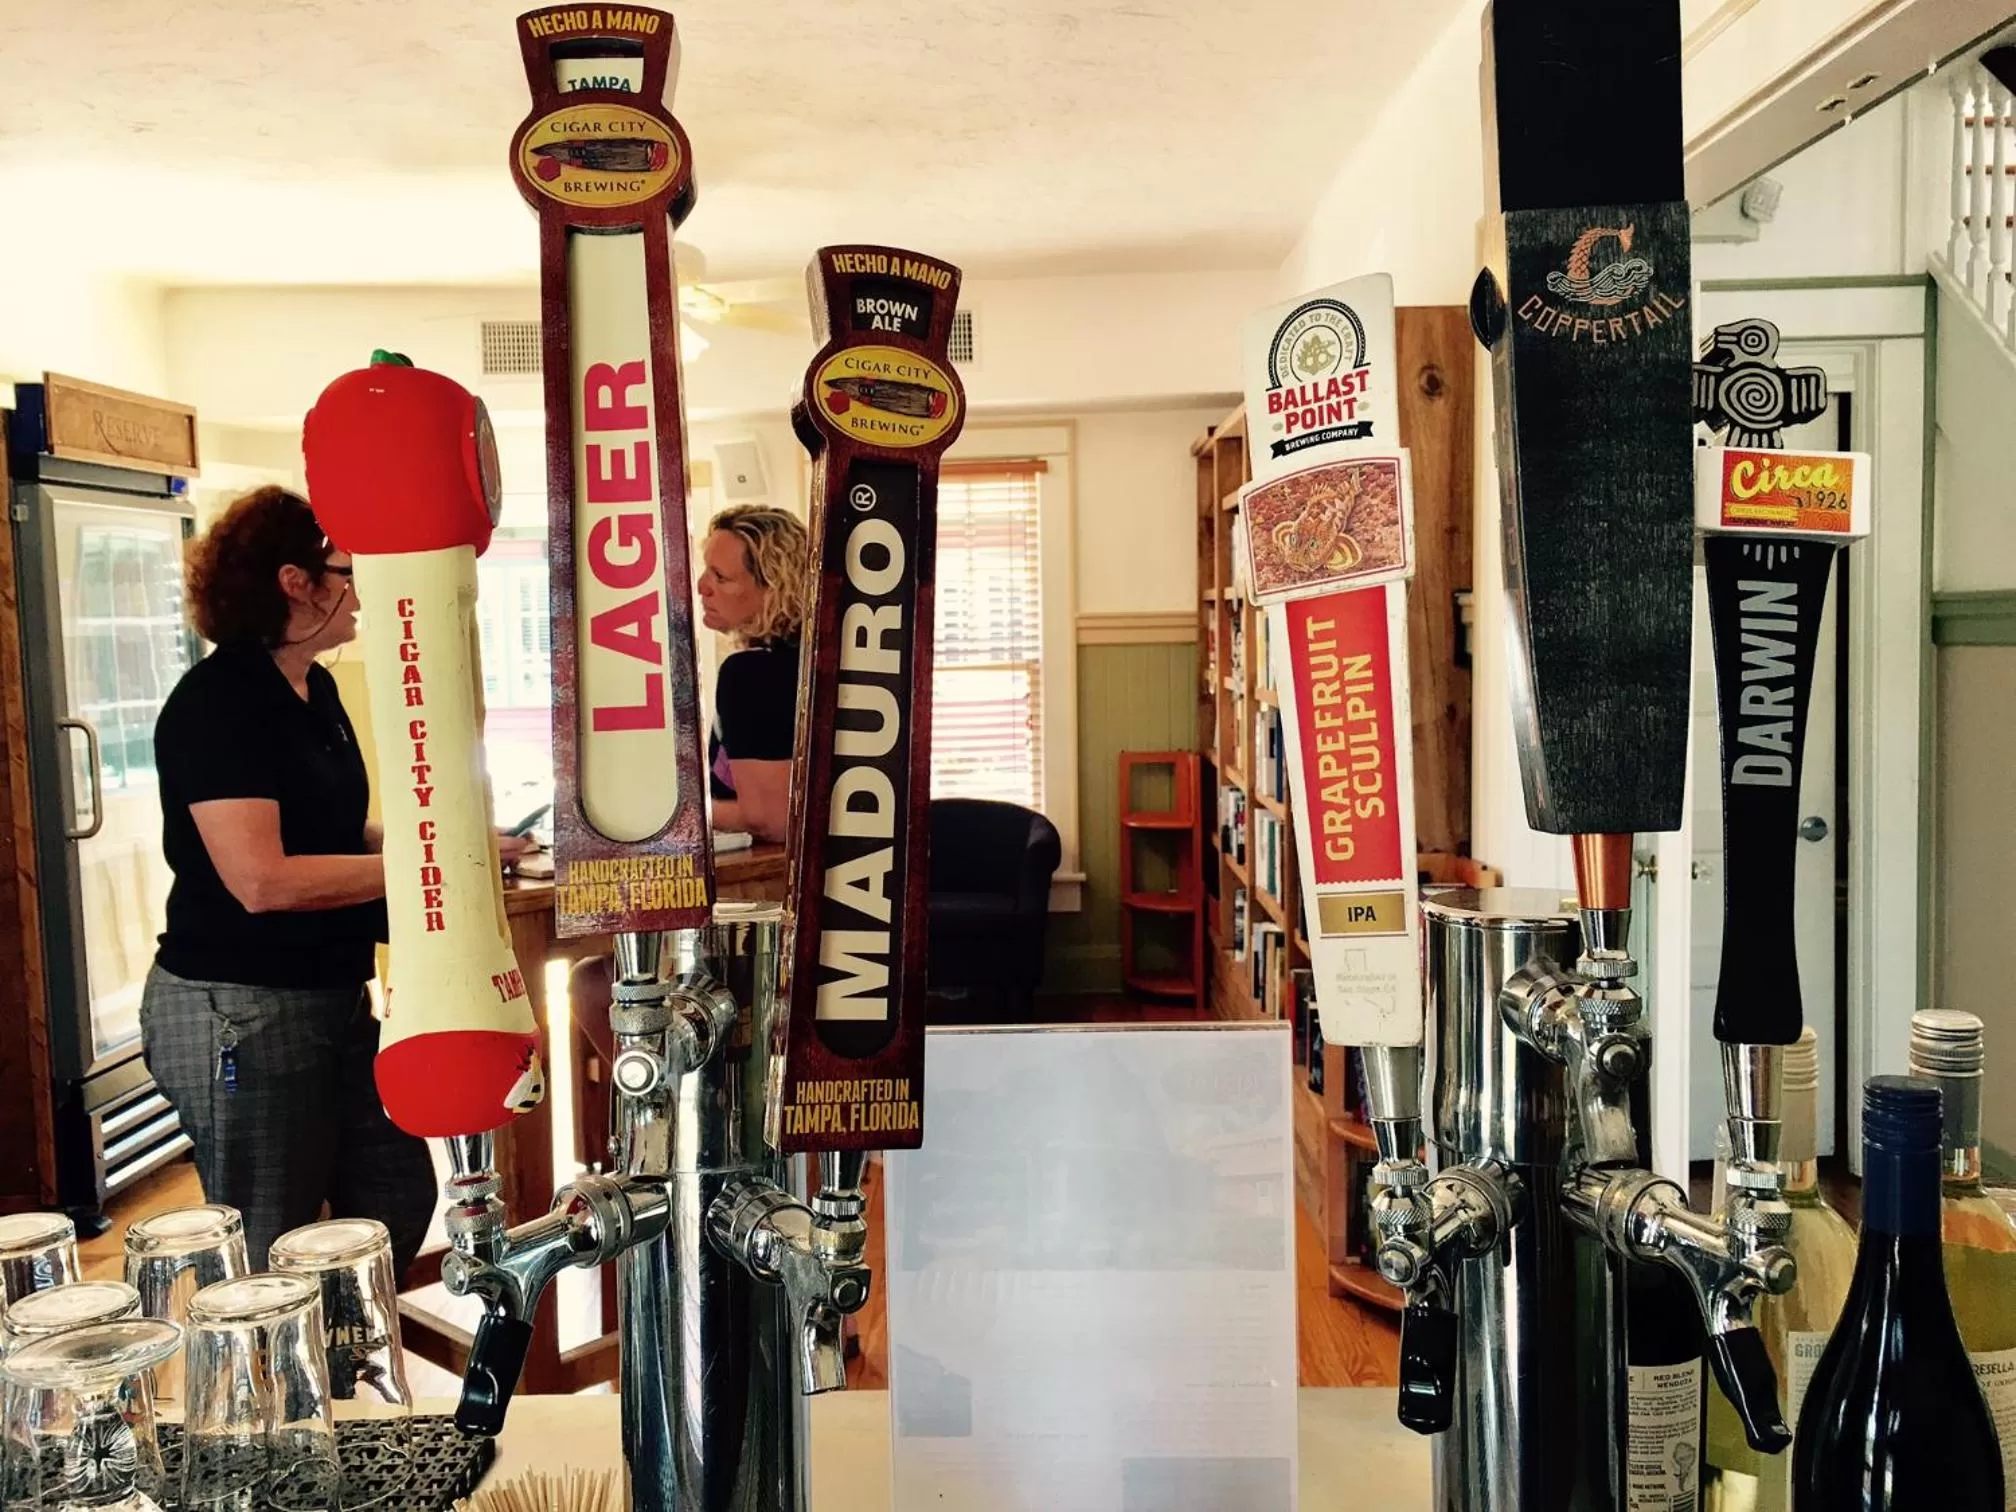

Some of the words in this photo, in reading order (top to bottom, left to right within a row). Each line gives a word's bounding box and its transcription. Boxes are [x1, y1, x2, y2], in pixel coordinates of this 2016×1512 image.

[527, 10, 588, 38] HECHO
[592, 10, 603, 28] A
[607, 10, 661, 34] MANO
[568, 76, 632, 92] TAMPA
[550, 121, 602, 133] CIGAR
[608, 121, 647, 132] CITY
[832, 253, 887, 274] HECHO
[890, 260, 900, 275] A
[904, 259, 952, 290] MANO
[856, 298, 918, 321] BROWN
[871, 315, 902, 333] ALE
[1309, 313, 1322, 323] TO
[1325, 312, 1343, 328] THE
[1517, 292, 1685, 343] COPPERTAIL
[844, 357, 892, 374] CIGAR
[896, 365, 931, 380] CITY
[1268, 369, 1369, 414] BALLAST
[1285, 398, 1358, 434] POINT
[1285, 434, 1320, 451] BREWING
[1321, 427, 1359, 440] COMPANY
[1730, 458, 1840, 500] Circa
[1806, 490, 1848, 510] 1926
[584, 360, 666, 732] LAGER
[397, 598, 425, 707] CIGAR
[1731, 580, 1799, 787] DARWIN
[1307, 616, 1356, 862] GRAPEFRUIT
[1342, 654, 1386, 820] SCULPIN
[409, 720, 433, 808] CITY
[418, 821, 446, 932] CIDER
[569, 855, 675, 884] HANDCRAFTED
[676, 853, 694, 878] IN
[630, 877, 708, 911] FLORIDA
[1347, 906, 1377, 923] IPA
[796, 1079, 893, 1104] HANDCRAFTED
[895, 1078, 910, 1101] IN
[784, 1104, 848, 1134] TAMPA,
[850, 1101, 919, 1132] FLORIDA
